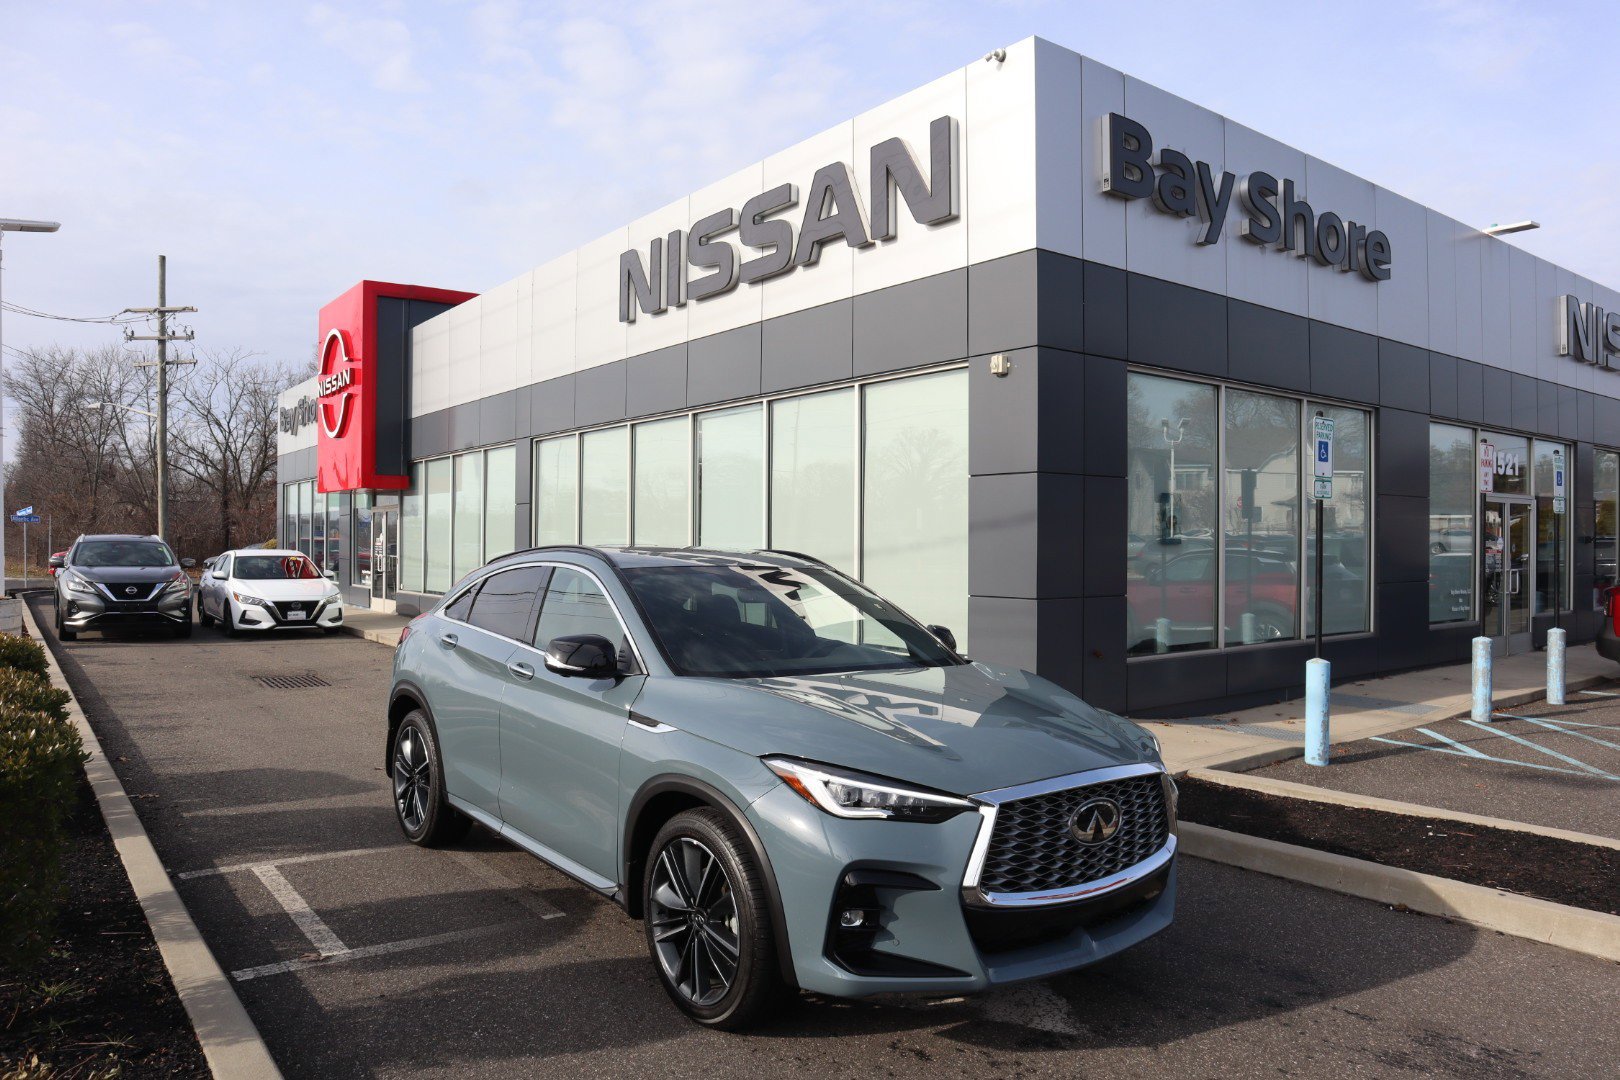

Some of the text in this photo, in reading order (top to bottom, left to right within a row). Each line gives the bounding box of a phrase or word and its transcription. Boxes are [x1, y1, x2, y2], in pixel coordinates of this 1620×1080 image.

[1102, 112, 1391, 282] Bay Shore
[619, 115, 959, 323] NISSAN
[319, 368, 351, 397] NISSAN
[280, 406, 298, 436] Bay
[1316, 431, 1332, 440] PARKING
[1493, 451, 1519, 476] 1521
